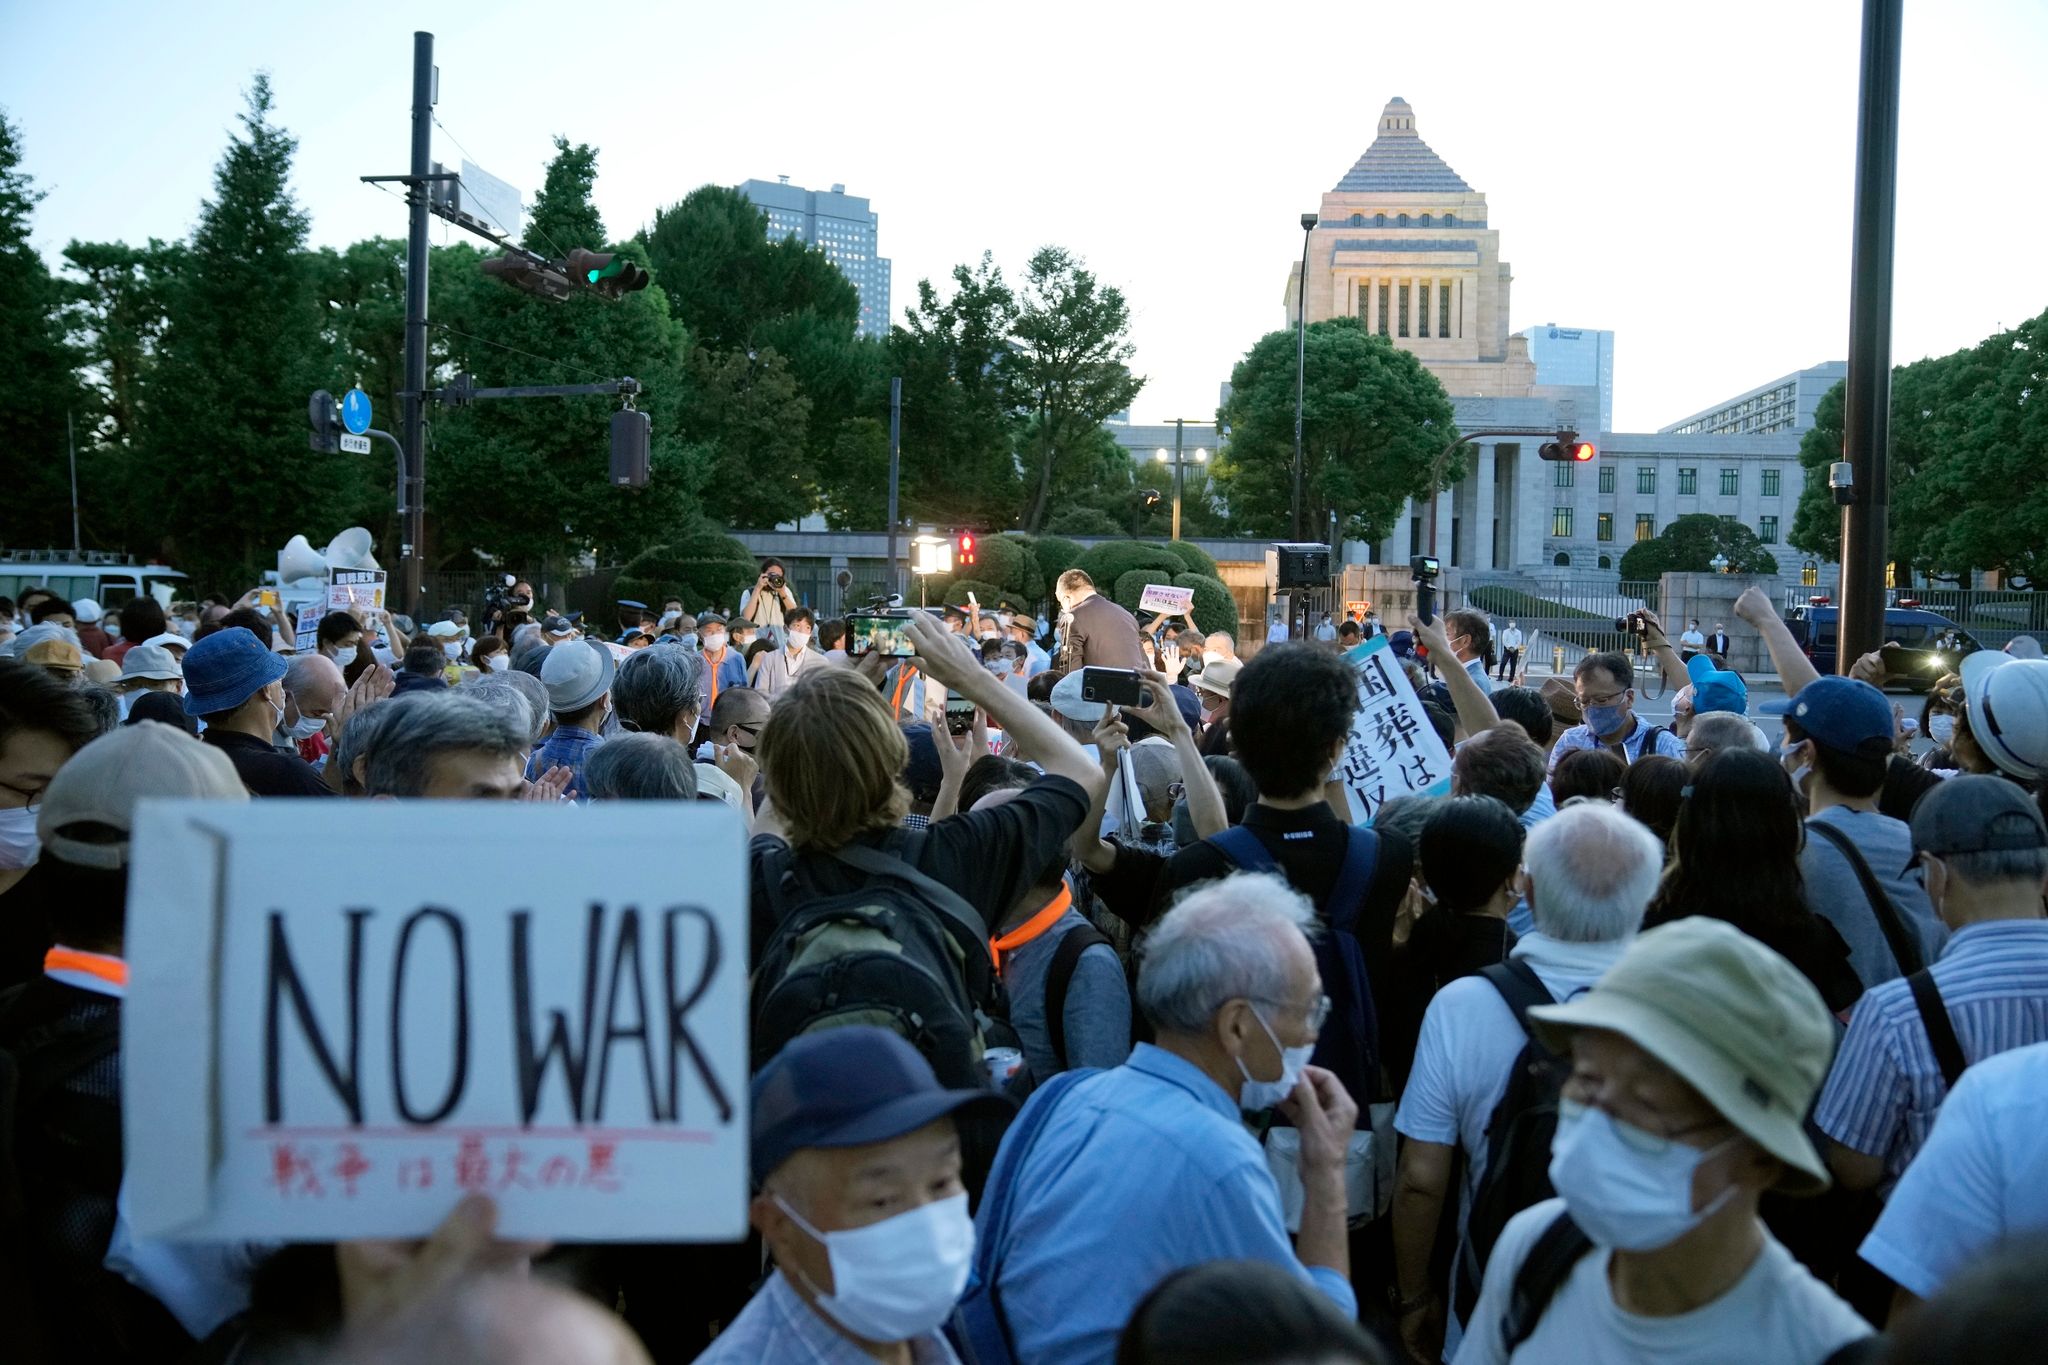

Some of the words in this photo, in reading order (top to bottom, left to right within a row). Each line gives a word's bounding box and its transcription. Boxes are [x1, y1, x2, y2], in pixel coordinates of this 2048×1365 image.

[1358, 654, 1436, 792] 国葬は
[263, 905, 471, 1128] NO
[509, 902, 735, 1130] WAR
